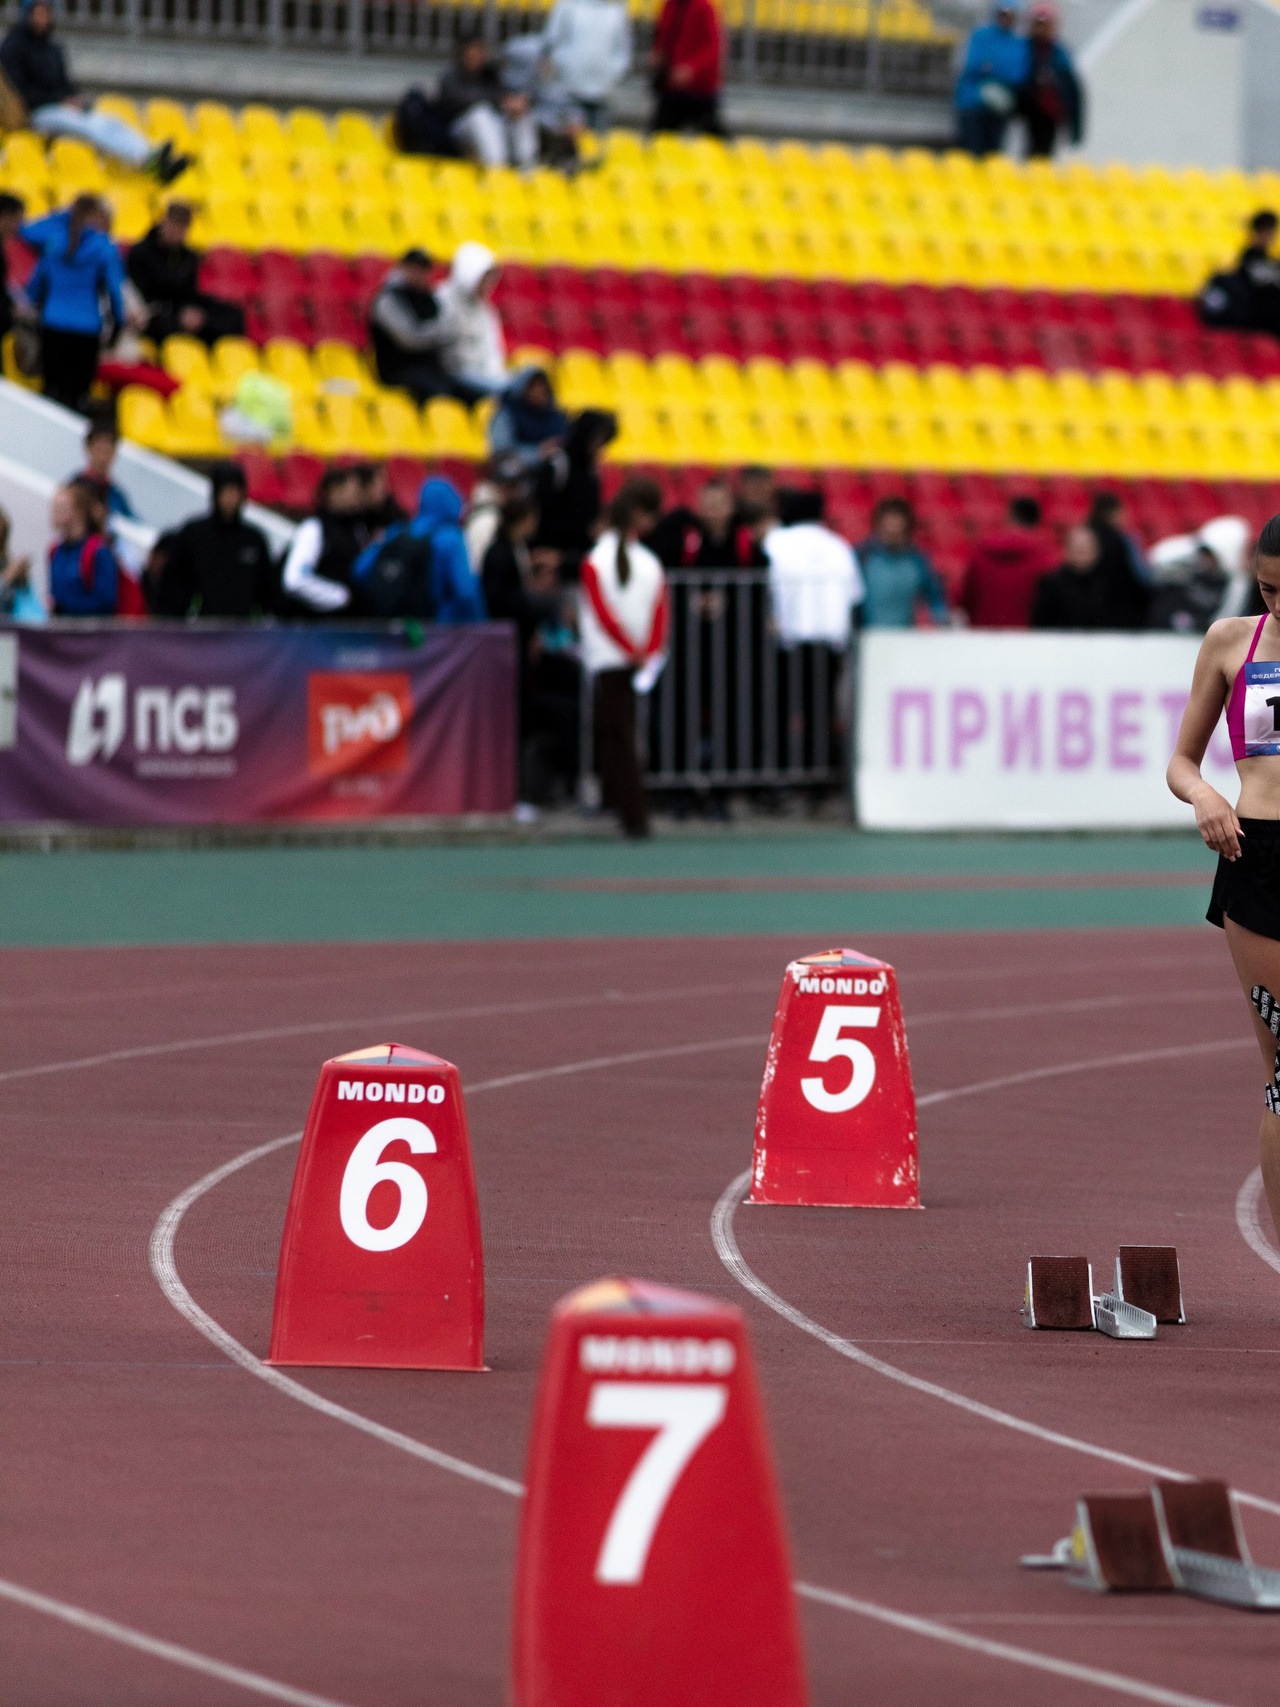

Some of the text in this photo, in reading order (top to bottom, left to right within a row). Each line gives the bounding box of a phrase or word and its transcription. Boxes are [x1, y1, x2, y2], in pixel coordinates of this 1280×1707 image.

[133, 687, 239, 753] ПСБ
[800, 977, 883, 995] MONDO
[338, 1081, 445, 1104] MONDO
[801, 1005, 881, 1113] 5
[339, 1117, 438, 1252] 6
[587, 1382, 729, 1586] 7
